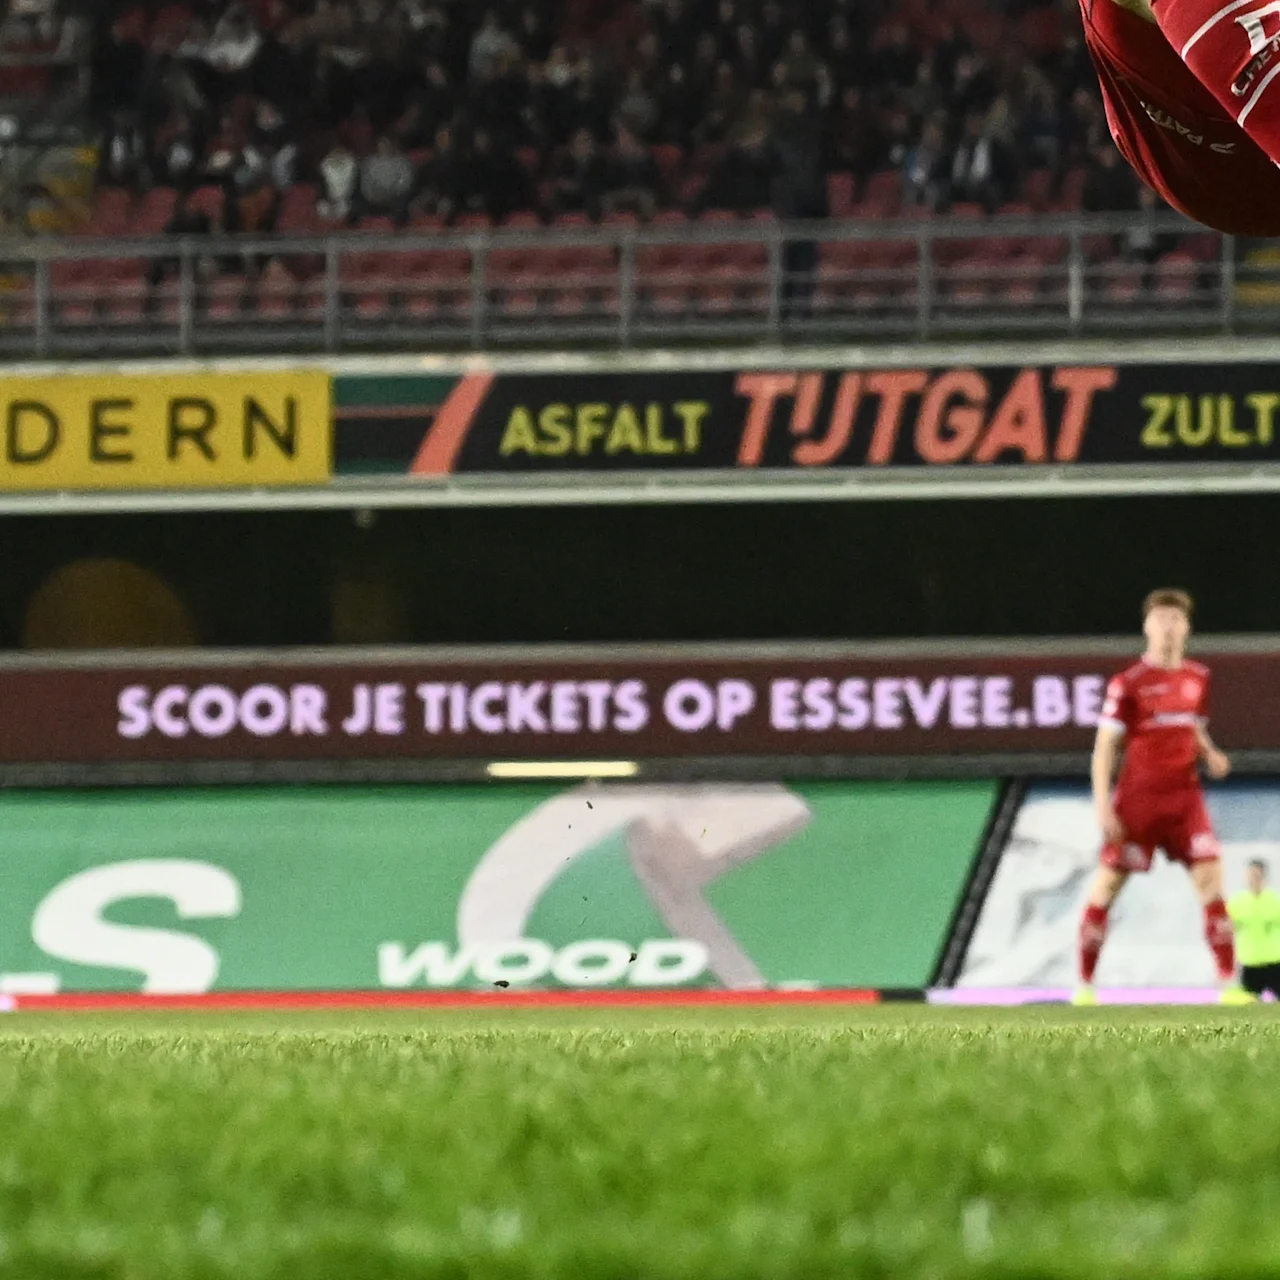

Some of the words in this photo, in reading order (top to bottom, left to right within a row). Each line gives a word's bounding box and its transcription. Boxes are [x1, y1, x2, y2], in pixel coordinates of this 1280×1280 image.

[6, 396, 297, 464] DERN
[499, 401, 709, 456] ASFALT
[117, 684, 328, 737] SCOOR
[343, 684, 405, 735] JE
[416, 680, 649, 734] TICKETS
[664, 678, 755, 731] OP
[770, 675, 1106, 730] ESSEVEE.BE
[377, 938, 708, 987] WOOD
